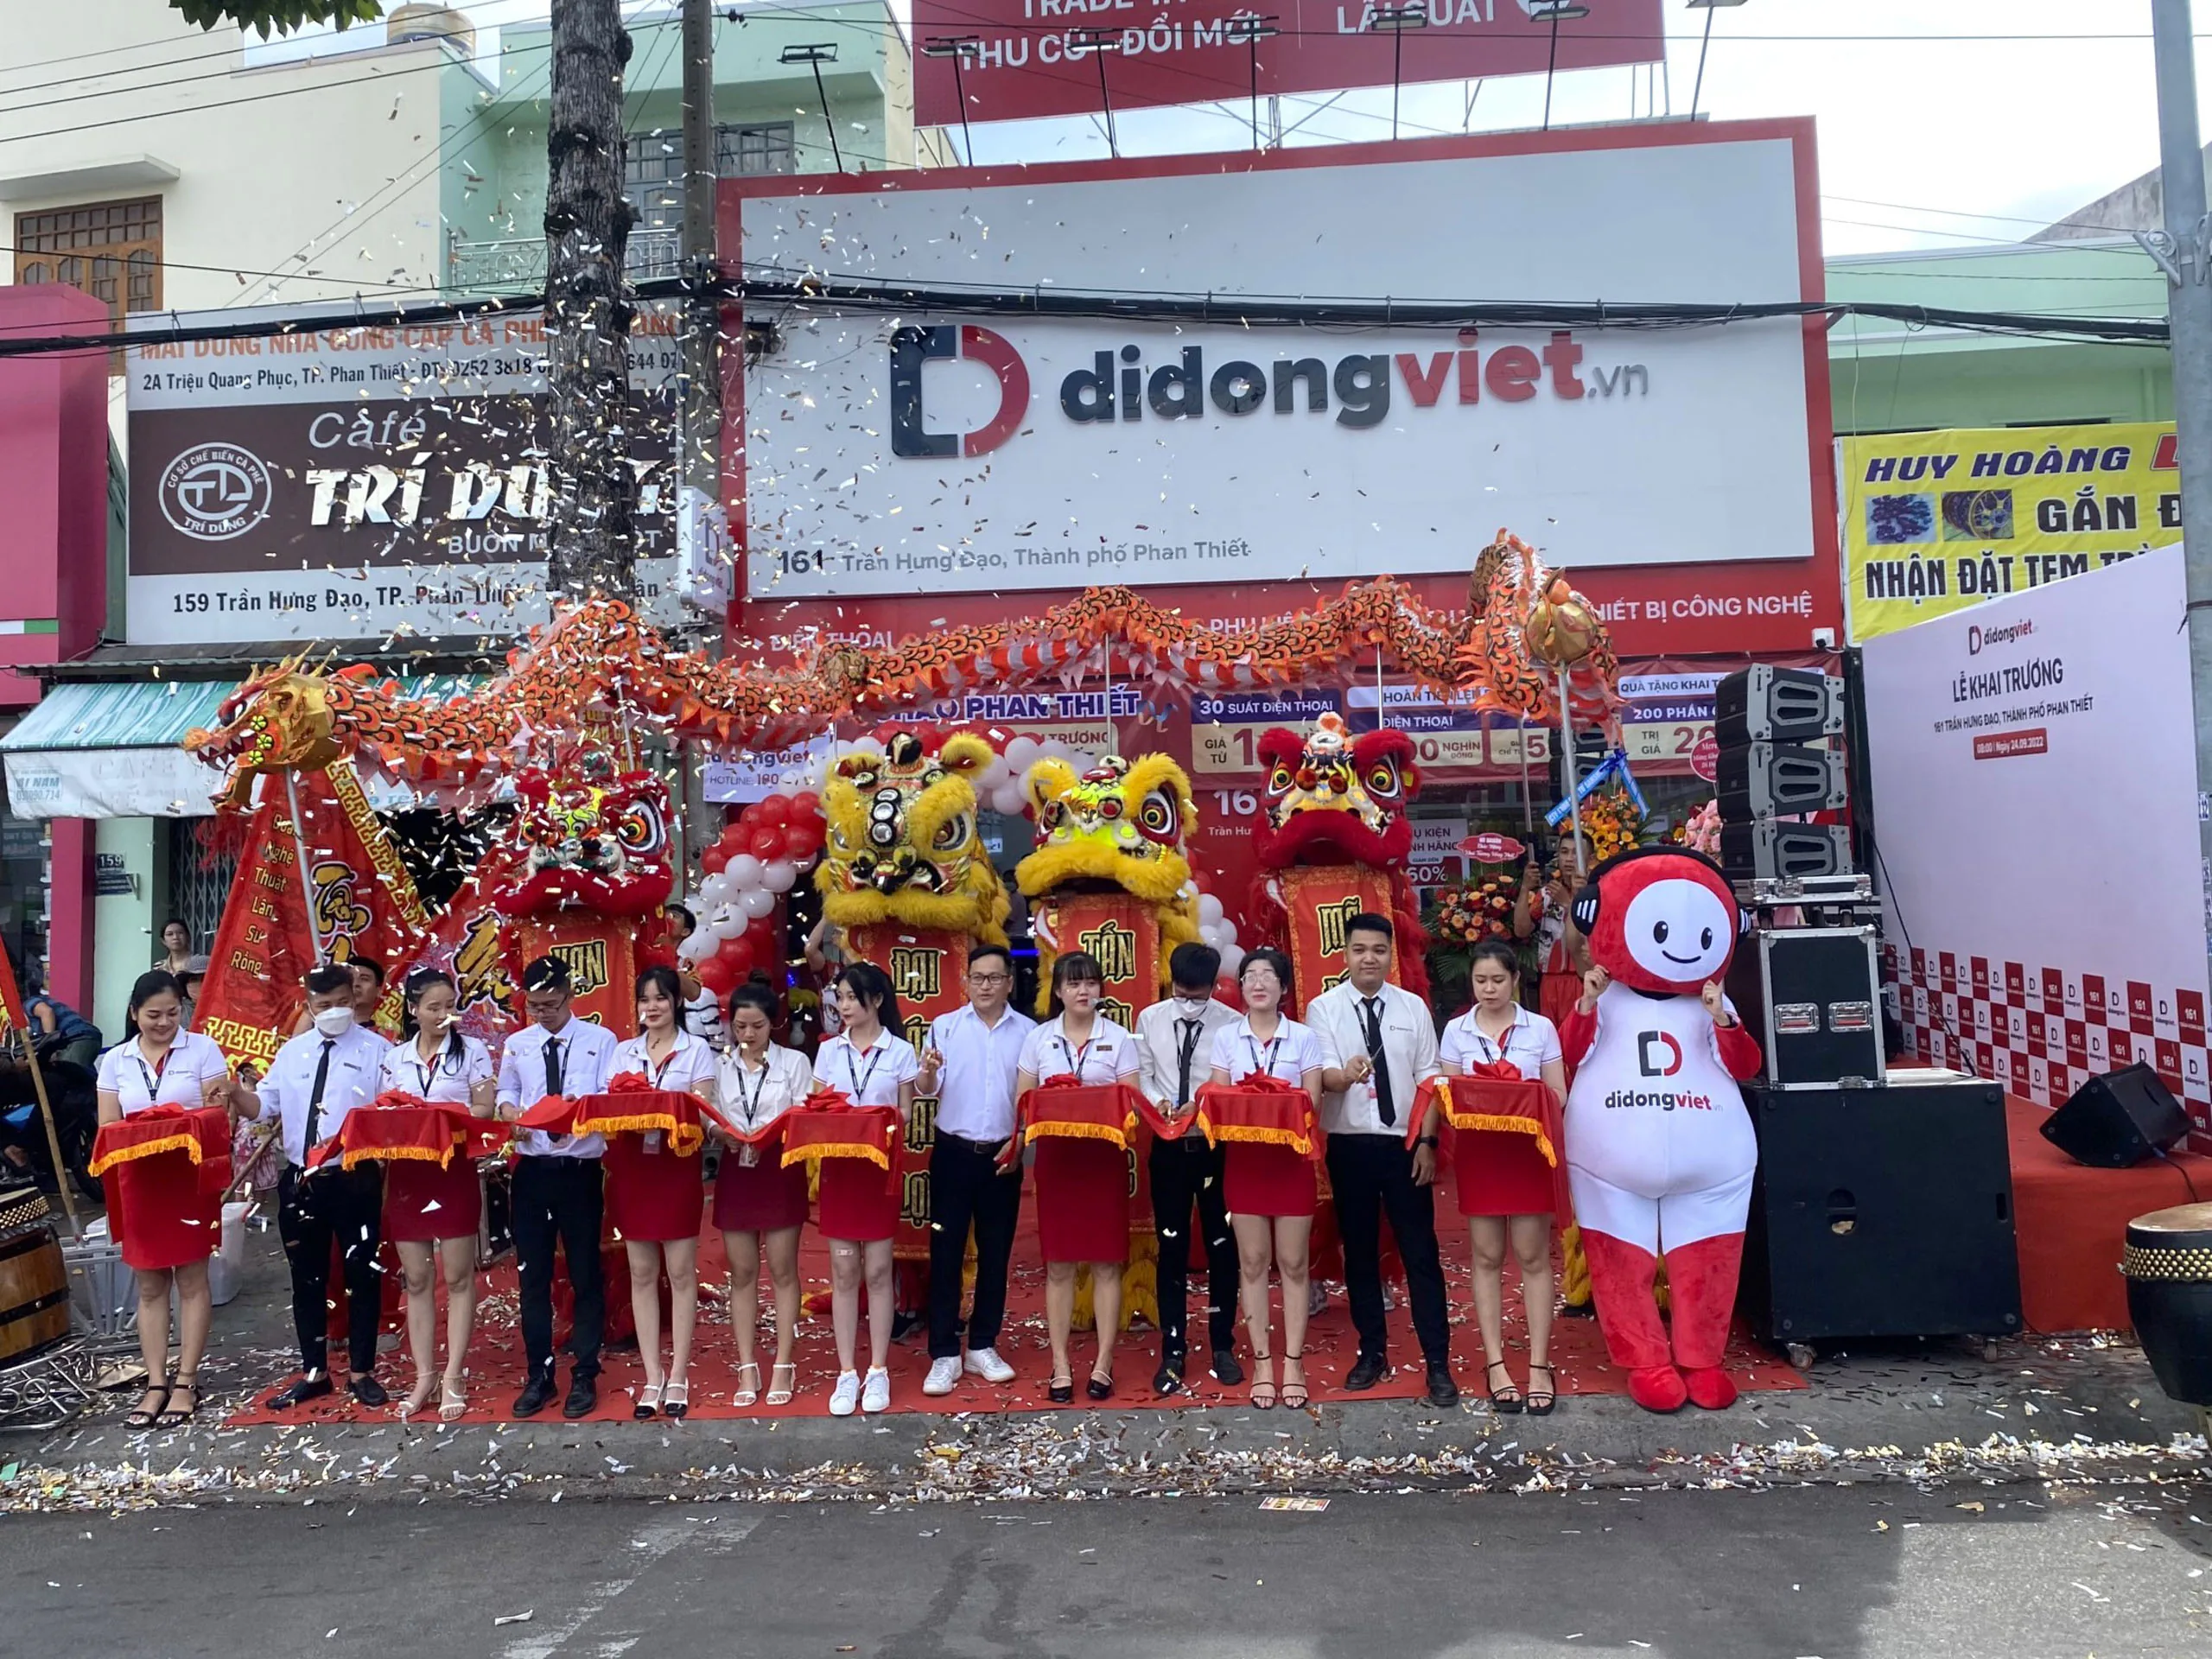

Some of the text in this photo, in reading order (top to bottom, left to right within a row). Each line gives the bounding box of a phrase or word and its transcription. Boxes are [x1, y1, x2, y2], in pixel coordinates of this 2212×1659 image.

[961, 37, 1029, 70] THU
[1120, 12, 1183, 56] ĐỔI
[143, 373, 162, 391] 2A
[167, 372, 203, 394] Triệu
[208, 371, 252, 391] Quang
[257, 369, 298, 390] Phục,
[331, 365, 365, 383] Phan
[370, 361, 406, 382] Thiết
[1864, 454, 1959, 482] HUY
[1971, 444, 2132, 478] HOÀNG
[306, 452, 433, 526] TRÍ
[2037, 485, 2137, 533] GẮN
[778, 537, 1249, 575] 161 Trần Hưng Đạo, Thành phố Phan Thiết
[1866, 551, 1947, 605] NHẬN
[1957, 550, 2014, 601] ĐẶT
[174, 593, 210, 613] 159
[216, 588, 263, 611] Trần
[269, 589, 318, 612] Hưng
[326, 588, 371, 612] Đạo,
[376, 586, 405, 606] TP.
[1597, 596, 1641, 621] HIẾT
[1645, 600, 1668, 624] BỊ
[1671, 594, 1743, 619] CÔNG
[1746, 589, 1814, 619] NGHỆ
[1620, 681, 1646, 693] QUÀ
[1648, 679, 1679, 693] TẶNG
[1681, 679, 1710, 690] KHAI
[1953, 657, 2063, 703] LỄ KHAI TRƯƠNG
[964, 694, 1052, 720] PHAN
[1056, 682, 1142, 717] THIẾT
[1199, 699, 1224, 715] 30
[1414, 715, 1453, 729] THOẠI
[1633, 707, 1662, 720] 200
[1934, 692, 2094, 734] 161 TRẦN HƯNG ĐẠO, THÀNH PHỐ PHAN THIẾT
[1205, 735, 1227, 749] GIÁ
[1442, 739, 1481, 753] NGHÌN
[1641, 730, 1659, 742] TRỊ
[1641, 744, 1661, 755] GIÁ
[1207, 825, 1232, 836] Trần
[1425, 827, 1451, 838] KIỆN
[100, 855, 122, 867] 159
[254, 866, 287, 893] Thuật
[230, 950, 264, 978] Rồng
[2134, 999, 2146, 1011] 161
[2184, 1007, 2197, 1020] 161
[2163, 1055, 2175, 1067] 161
